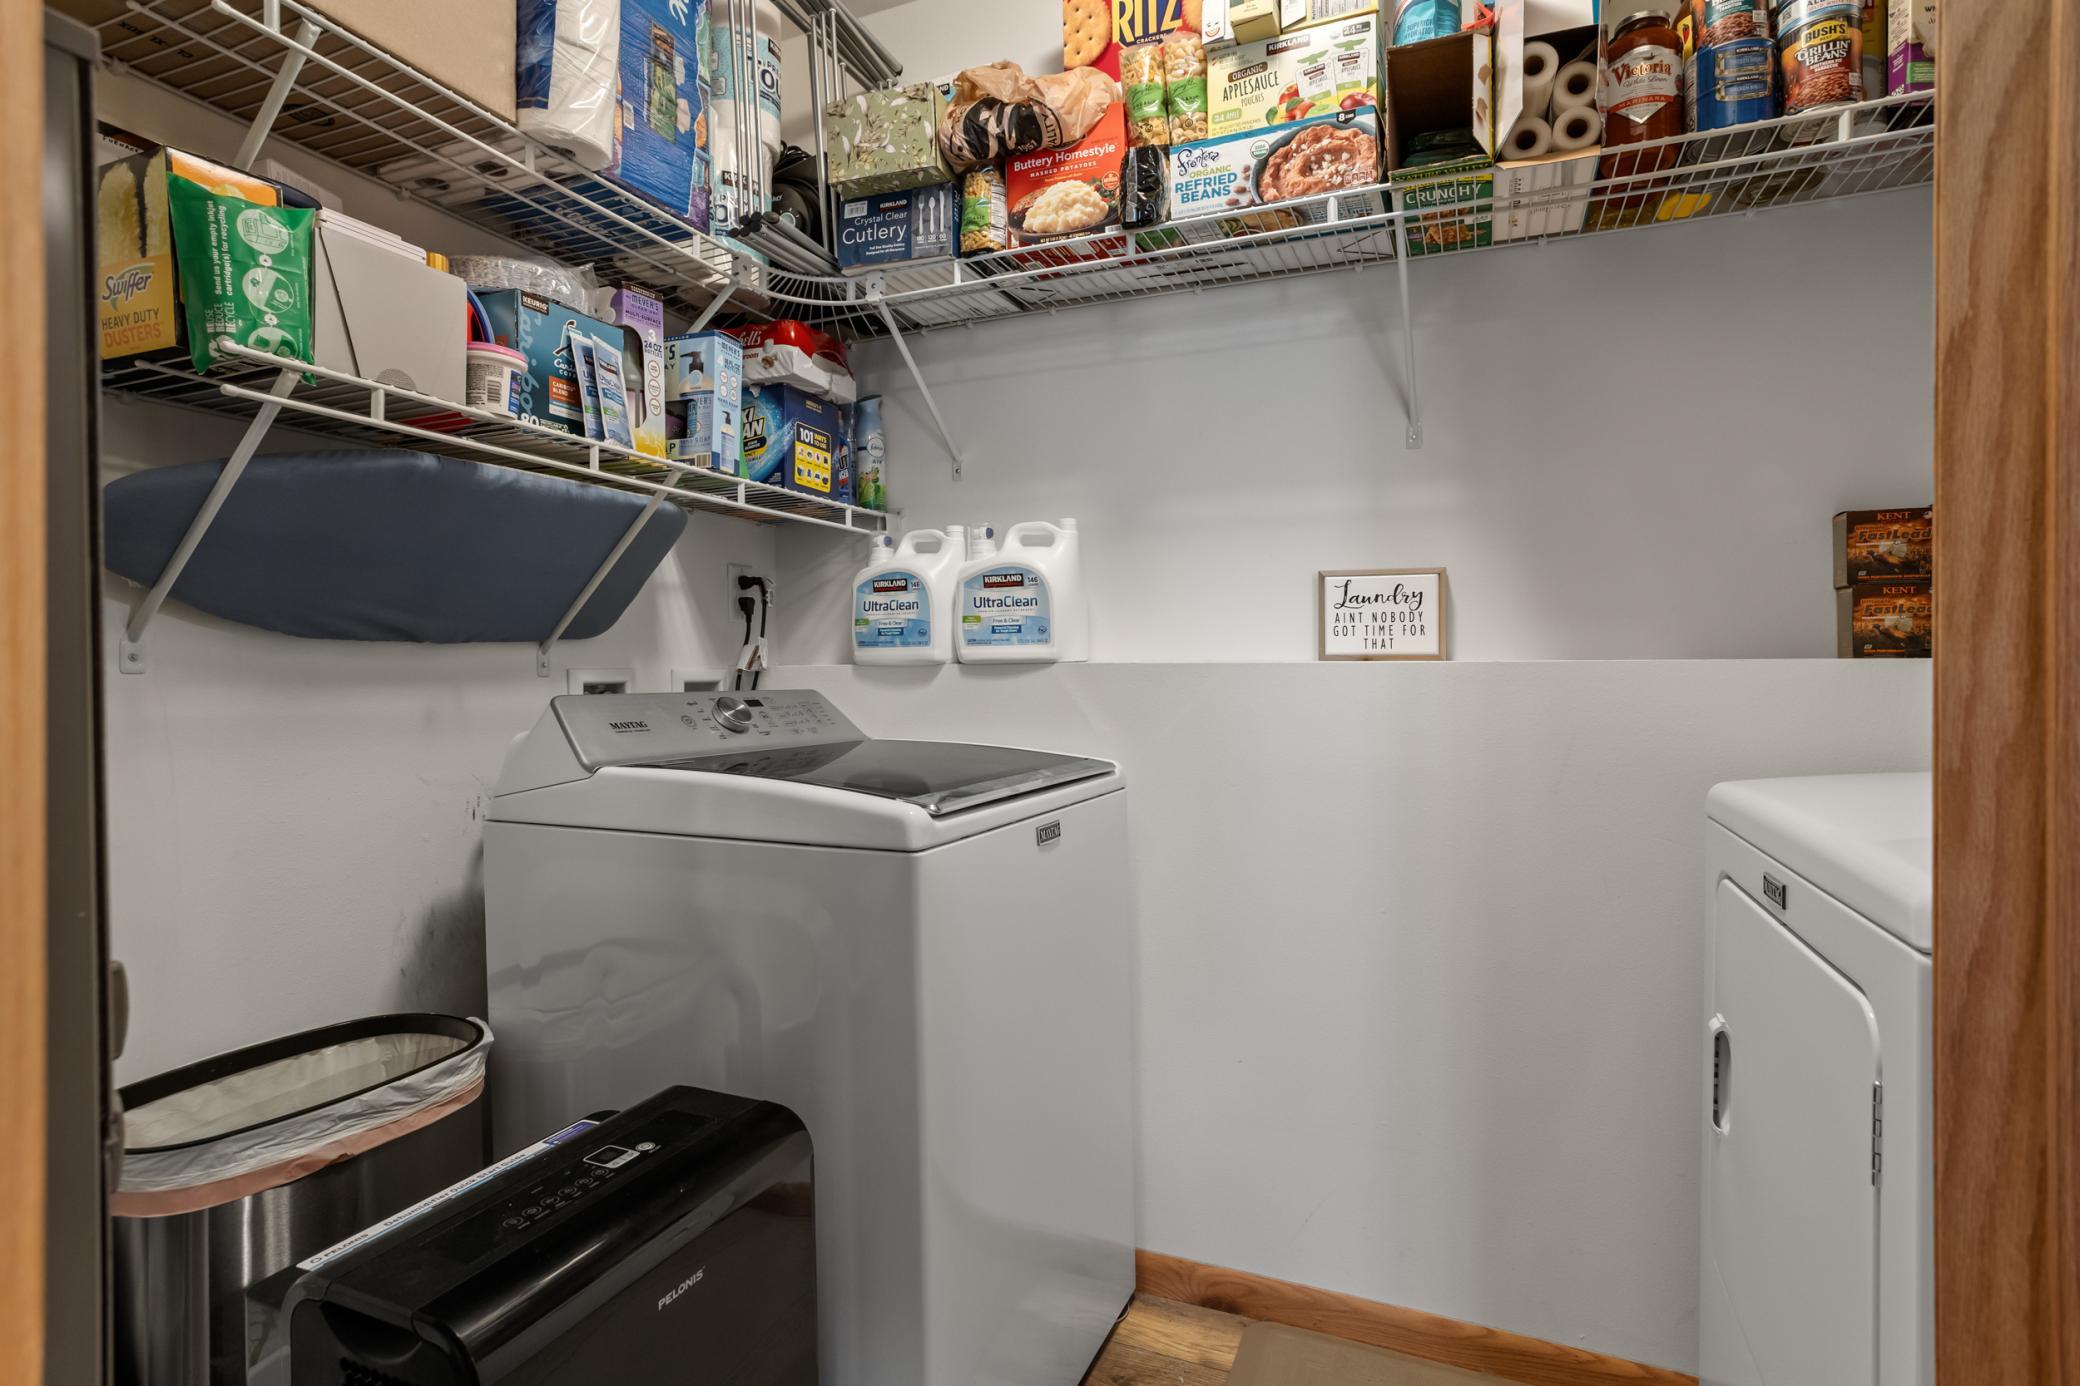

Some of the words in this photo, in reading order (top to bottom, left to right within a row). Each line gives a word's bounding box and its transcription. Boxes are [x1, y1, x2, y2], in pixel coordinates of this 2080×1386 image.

[1112, 0, 1183, 44] RITZ
[1806, 23, 1846, 41] BUSH'S
[1268, 37, 1309, 51] KIRKLAND
[1805, 49, 1847, 67] BEANS
[1232, 64, 1263, 80] ORGANIC
[1611, 60, 1672, 87] Victoria
[1223, 71, 1279, 102] APPLESAUCE
[1241, 93, 1264, 107] POUCHES
[1338, 113, 1345, 121] 8
[1014, 156, 1053, 172] Buttery
[1055, 143, 1116, 162] Homestyle
[1030, 168, 1058, 178] MASHED
[1060, 161, 1097, 172] POTATOES
[1189, 164, 1232, 179] ORGANIC
[1175, 172, 1238, 194] REFRIED
[1181, 185, 1231, 204] BEANS
[1406, 184, 1481, 204] CRUNCHY
[855, 213, 883, 227] Crystal
[885, 211, 908, 221] Clear
[843, 223, 907, 245] Cutlery
[102, 272, 153, 302] Swiffer
[102, 313, 130, 331] HEAVY
[133, 308, 160, 324] DUTY
[214, 303, 224, 333] REDUCE
[223, 301, 237, 334] RECYCLE
[104, 321, 162, 349] DUSTERS
[648, 329, 656, 342] 3
[644, 340, 652, 349] 24
[800, 428, 814, 445] 101
[1877, 511, 1911, 520] KENT
[873, 579, 906, 588] KIRKLAND
[984, 575, 1022, 583] KIRKLAND
[1333, 579, 1423, 611] Laundry
[1883, 586, 1916, 594] KENT
[863, 600, 919, 612] UltraClean
[973, 596, 1038, 609] UltraClean
[1335, 611, 1363, 624] AINT
[1372, 611, 1423, 623] NOBODY
[1333, 625, 1356, 637] GOT
[1364, 624, 1394, 636] TIME
[1403, 624, 1426, 636] FOR
[1364, 638, 1394, 650] THAT
[609, 721, 648, 730] MAYTAG
[658, 1268, 704, 1311] PELONIS
